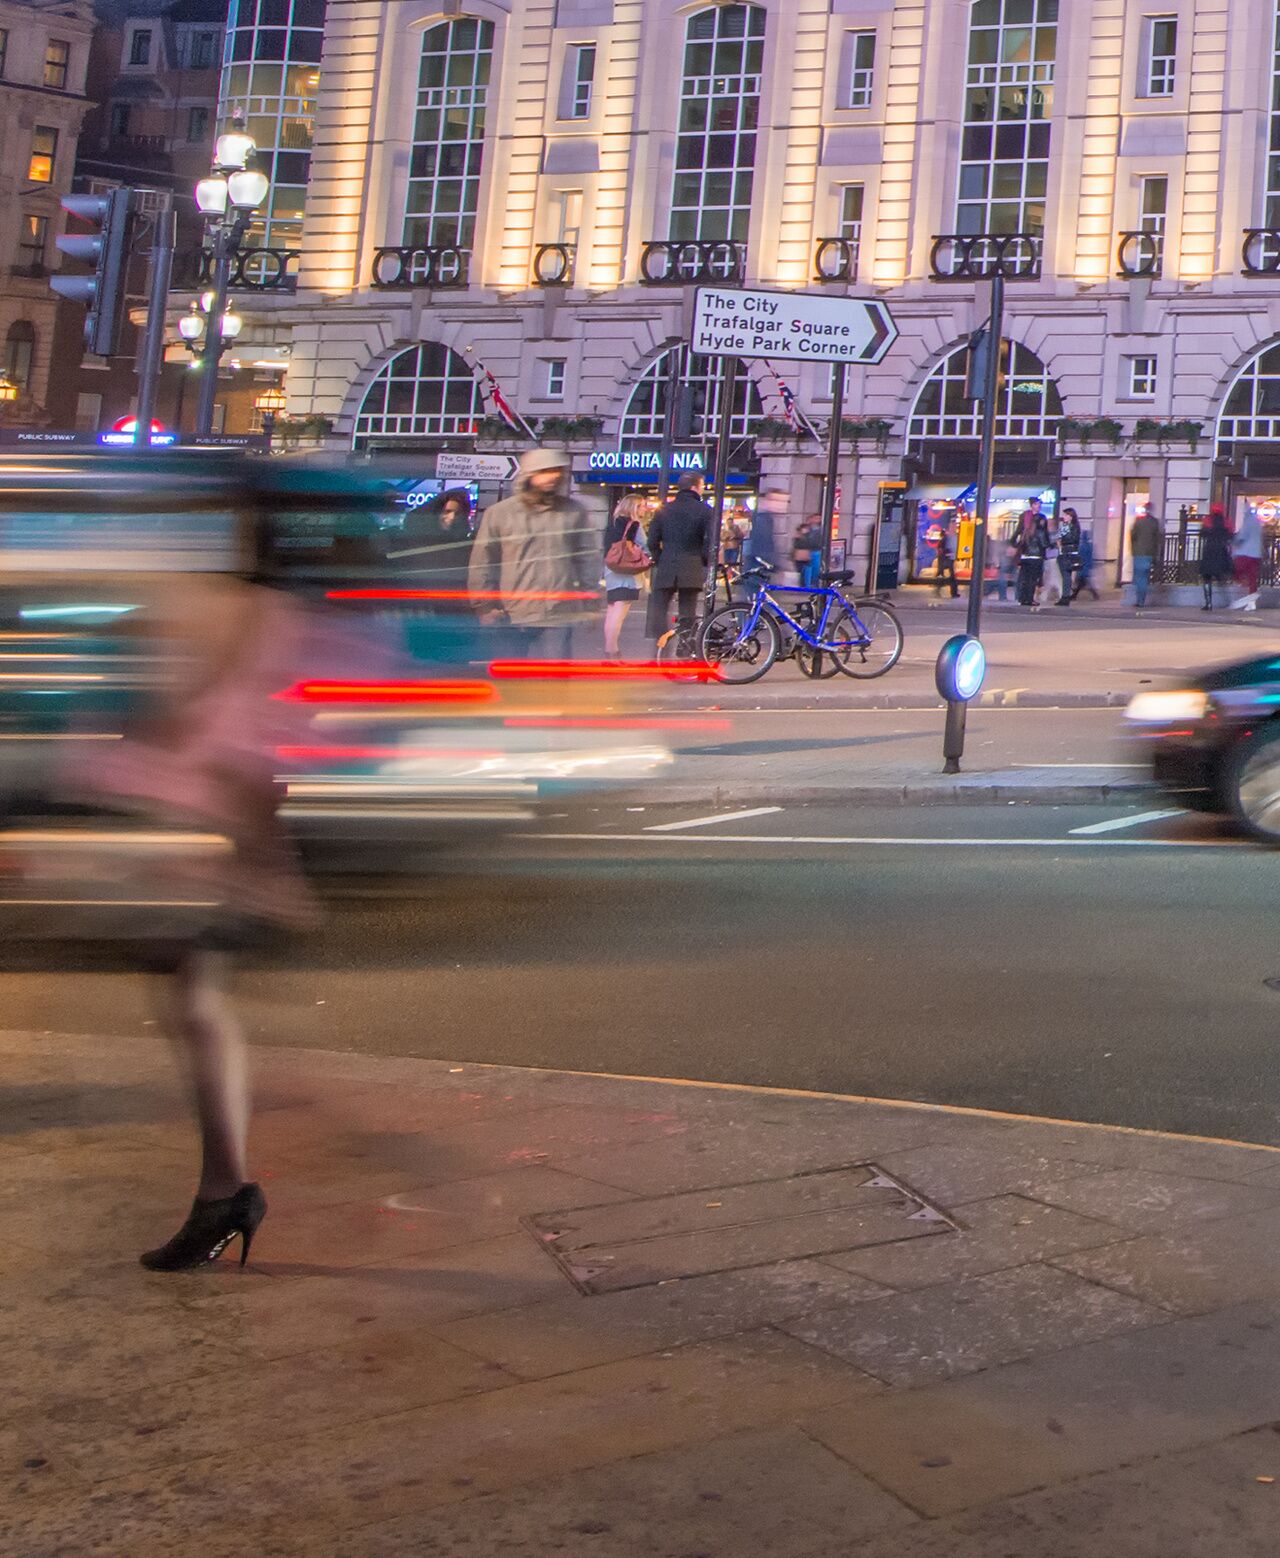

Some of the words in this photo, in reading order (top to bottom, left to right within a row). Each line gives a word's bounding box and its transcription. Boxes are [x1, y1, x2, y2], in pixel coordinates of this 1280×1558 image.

[704, 294, 736, 310] The
[743, 297, 779, 315] City
[702, 313, 783, 334] Trafalgar
[790, 319, 850, 337] Square
[699, 332, 745, 350] Hyde
[752, 336, 791, 352] Park
[798, 339, 856, 355] Corner
[18, 433, 43, 441] PUBLIC
[44, 433, 76, 442] SUBWAY
[456, 456, 472, 464] City
[589, 452, 622, 468] COOL
[623, 452, 704, 468] BRITANIA
[439, 462, 473, 470] Trafalgar
[475, 463, 501, 472] Square
[438, 470, 457, 478] Hyde
[459, 470, 476, 478] Park
